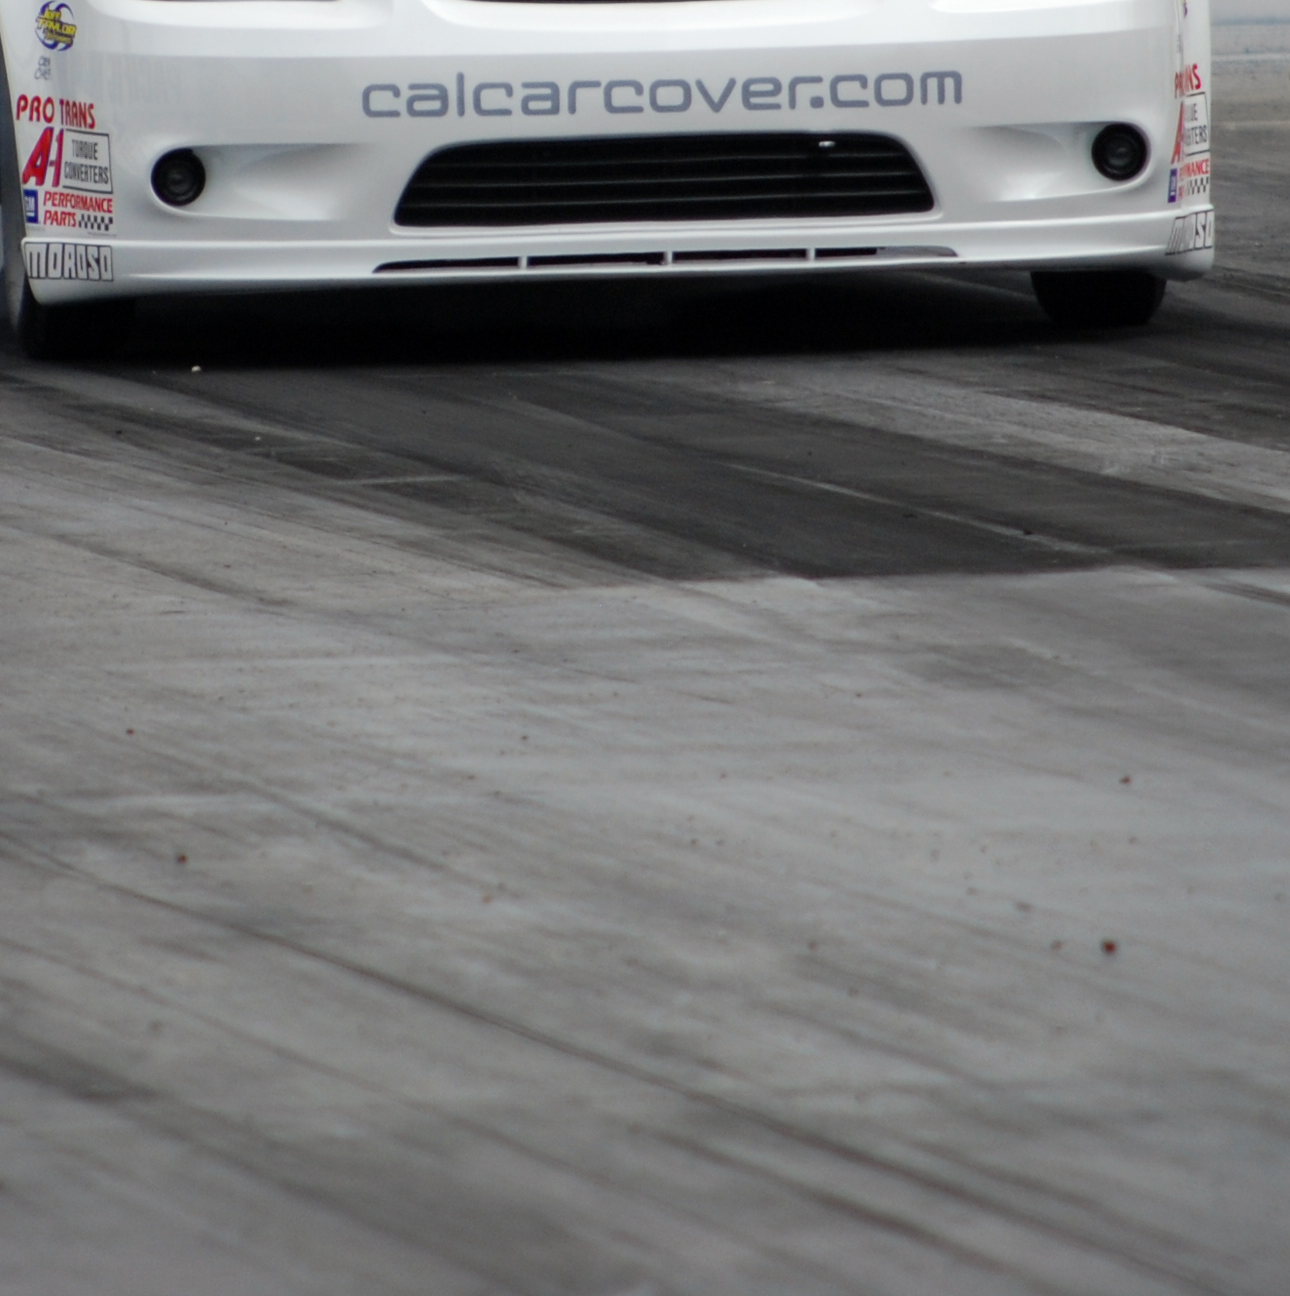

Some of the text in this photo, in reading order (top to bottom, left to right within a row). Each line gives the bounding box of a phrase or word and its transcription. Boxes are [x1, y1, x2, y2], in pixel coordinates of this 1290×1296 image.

[360, 70, 963, 120] calcarcover.com
[15, 94, 96, 130] PRO TRANS
[21, 126, 65, 188] A-1
[71, 138, 99, 161] TORQUE
[63, 160, 110, 185] CONVERTERS
[43, 190, 114, 214] PERFORMANCE
[43, 209, 77, 228] PARTS
[24, 241, 114, 283] MOROSO
